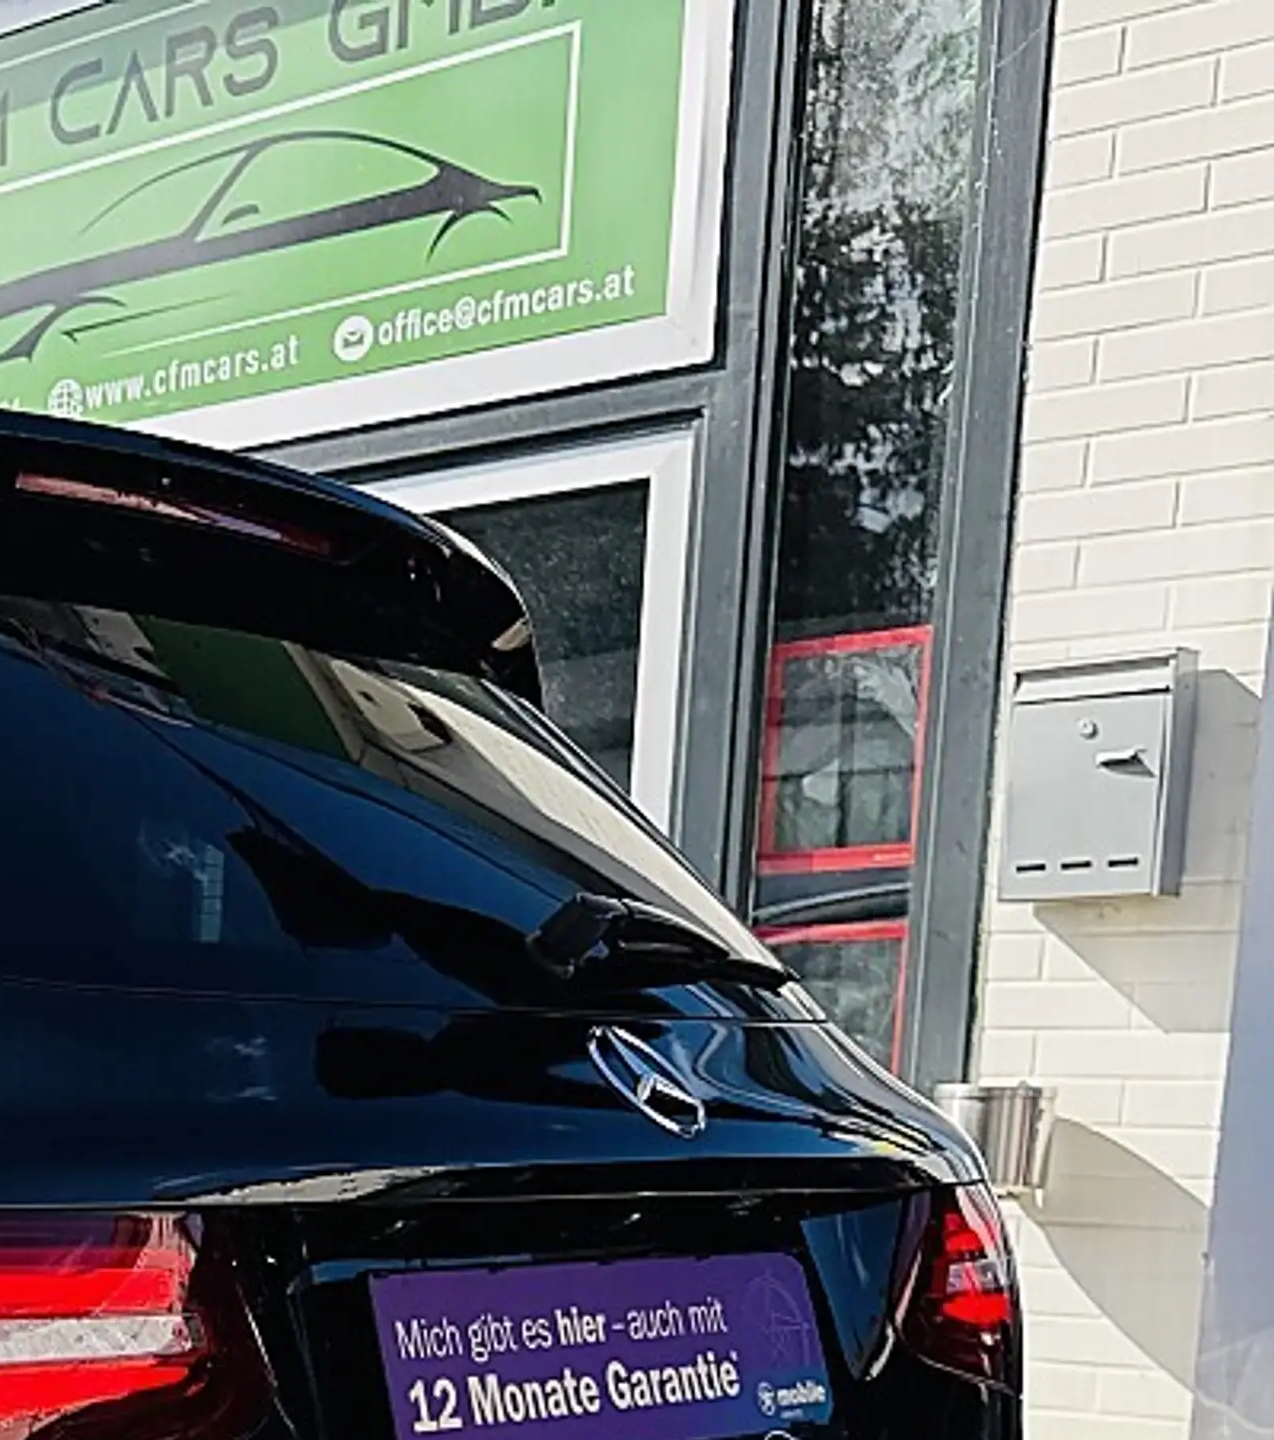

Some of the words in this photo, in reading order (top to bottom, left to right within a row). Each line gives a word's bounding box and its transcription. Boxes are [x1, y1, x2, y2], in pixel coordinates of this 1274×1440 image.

[50, 5, 279, 145] CARS
[377, 265, 635, 346] office@cfmcars.at
[84, 334, 299, 409] www.cfmcars.at
[394, 1316, 463, 1360] Mich
[467, 1312, 519, 1362] gibt
[521, 1317, 553, 1349] es
[554, 1305, 606, 1346] hier
[687, 1296, 728, 1334] mit
[409, 1376, 463, 1433] 12
[467, 1366, 600, 1427] Monate
